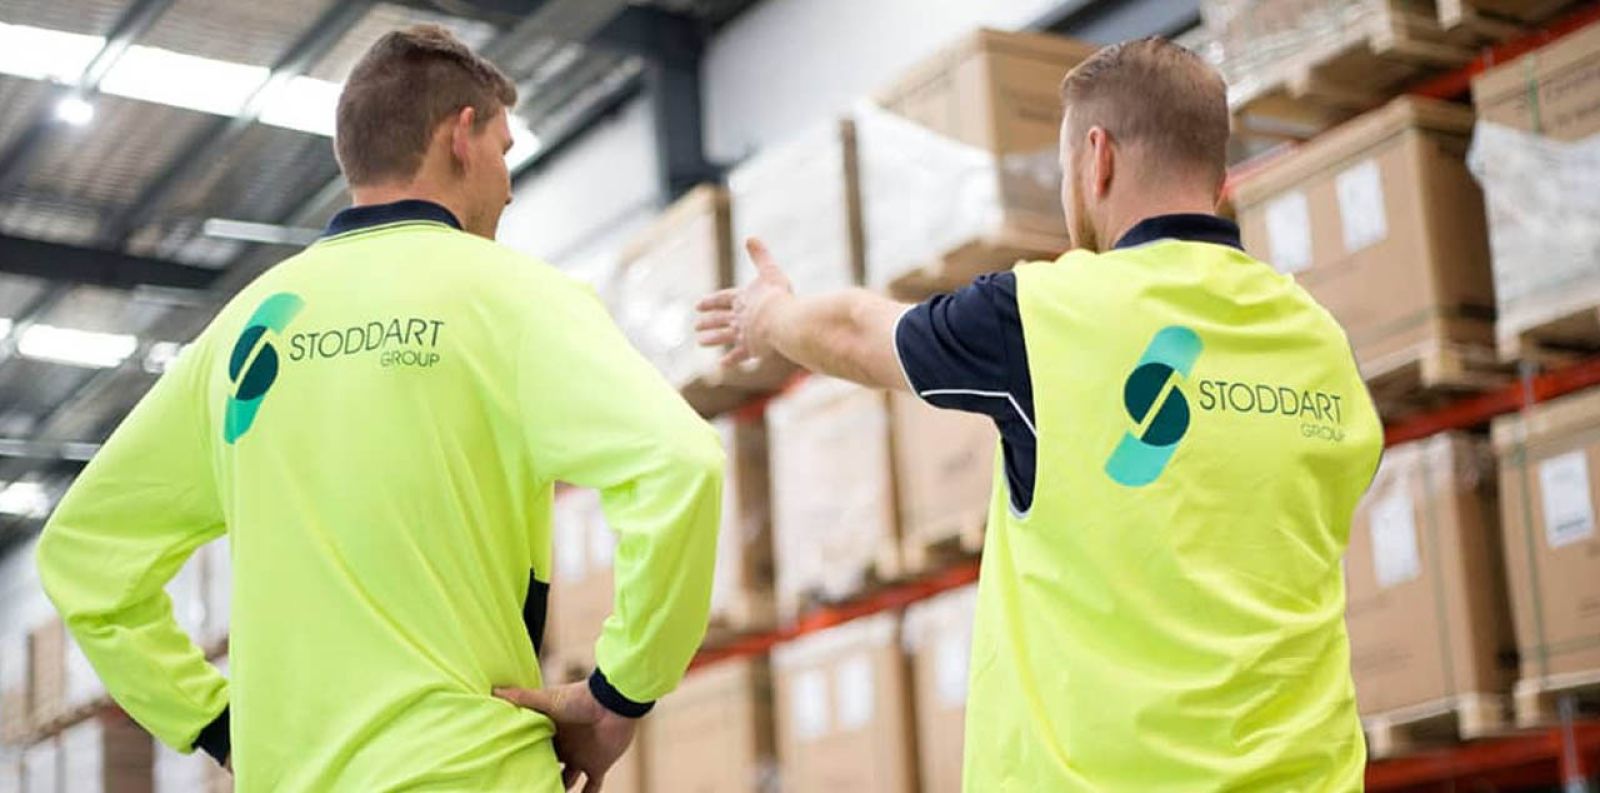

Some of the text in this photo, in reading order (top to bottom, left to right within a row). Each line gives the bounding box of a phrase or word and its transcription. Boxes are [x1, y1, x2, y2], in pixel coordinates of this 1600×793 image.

[289, 318, 444, 361] STODDART
[380, 350, 441, 368] GROUP
[1199, 380, 1341, 423] STODDART
